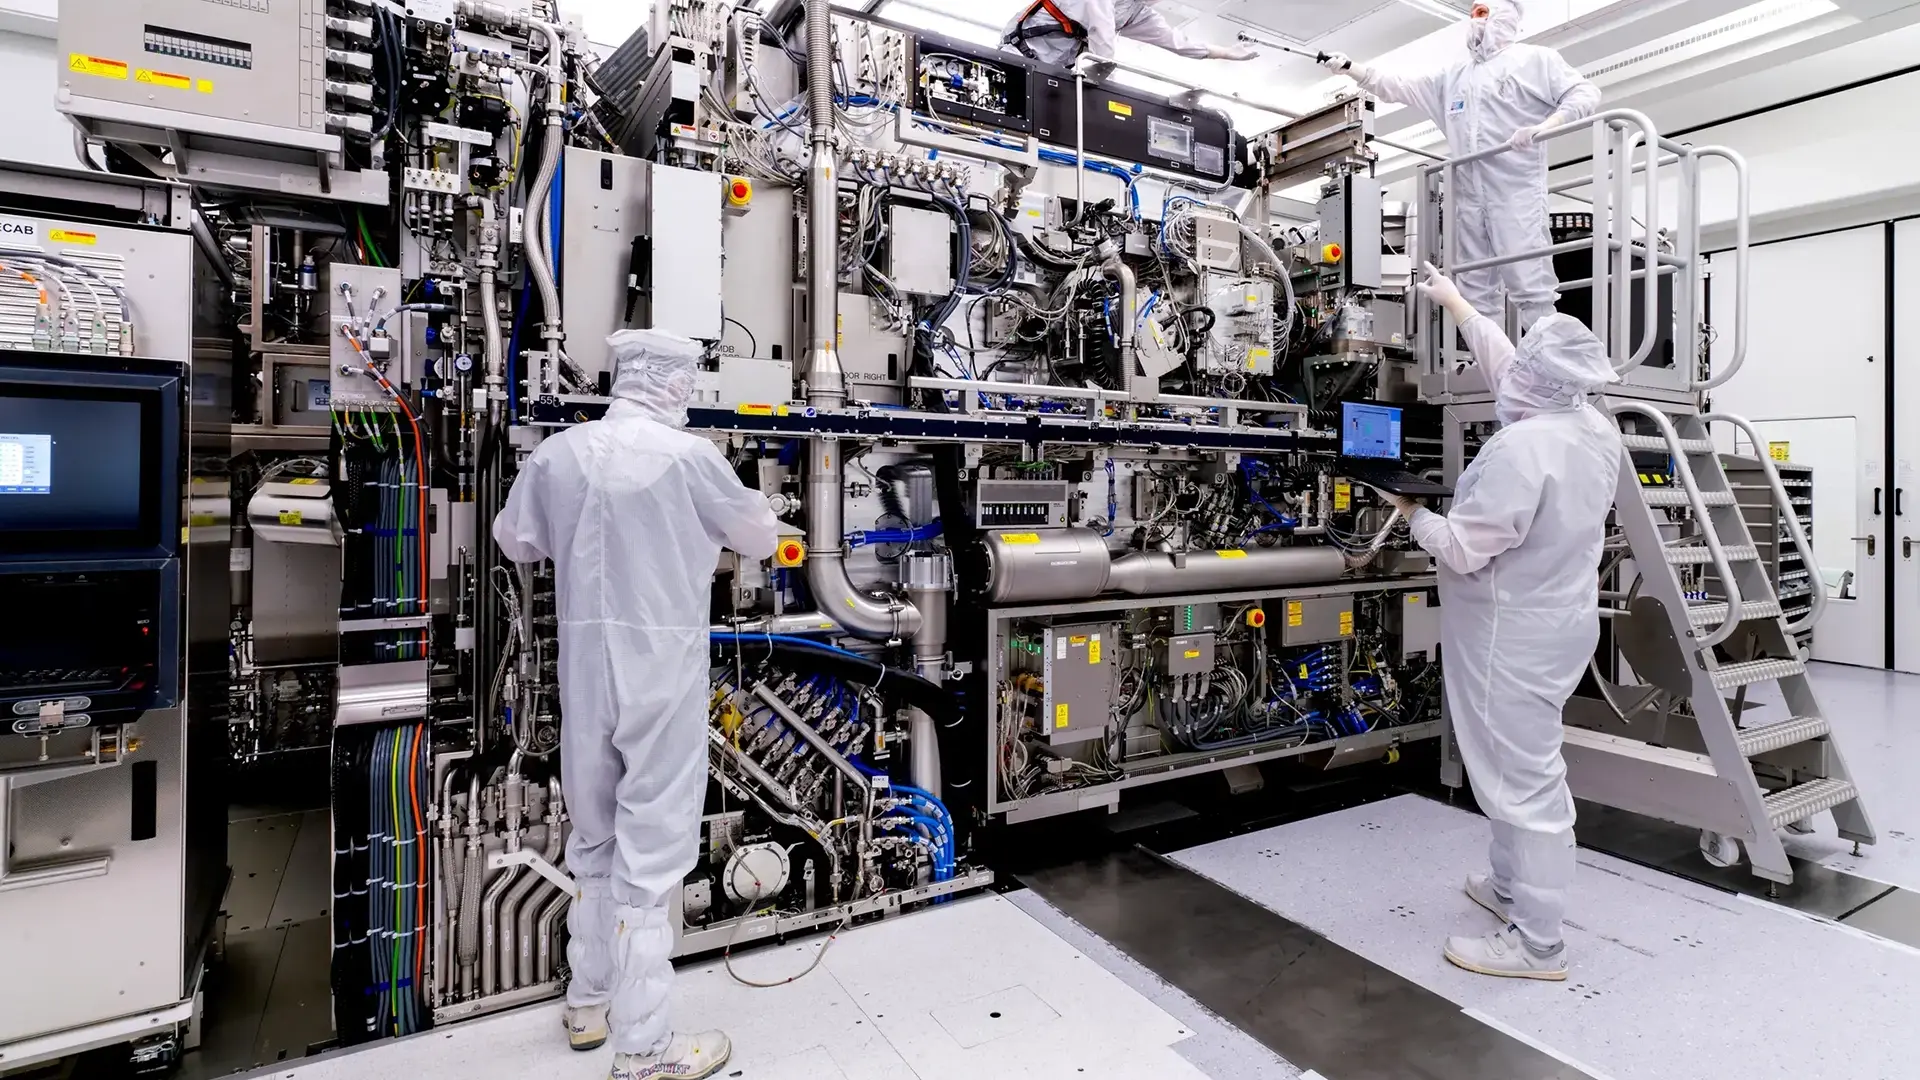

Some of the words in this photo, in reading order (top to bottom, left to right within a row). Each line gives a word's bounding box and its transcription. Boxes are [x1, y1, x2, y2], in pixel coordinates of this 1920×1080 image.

[0, 222, 34, 235] CAB
[844, 371, 860, 380] OOR
[864, 372, 886, 381] RIGHT
[540, 396, 553, 405] 55
